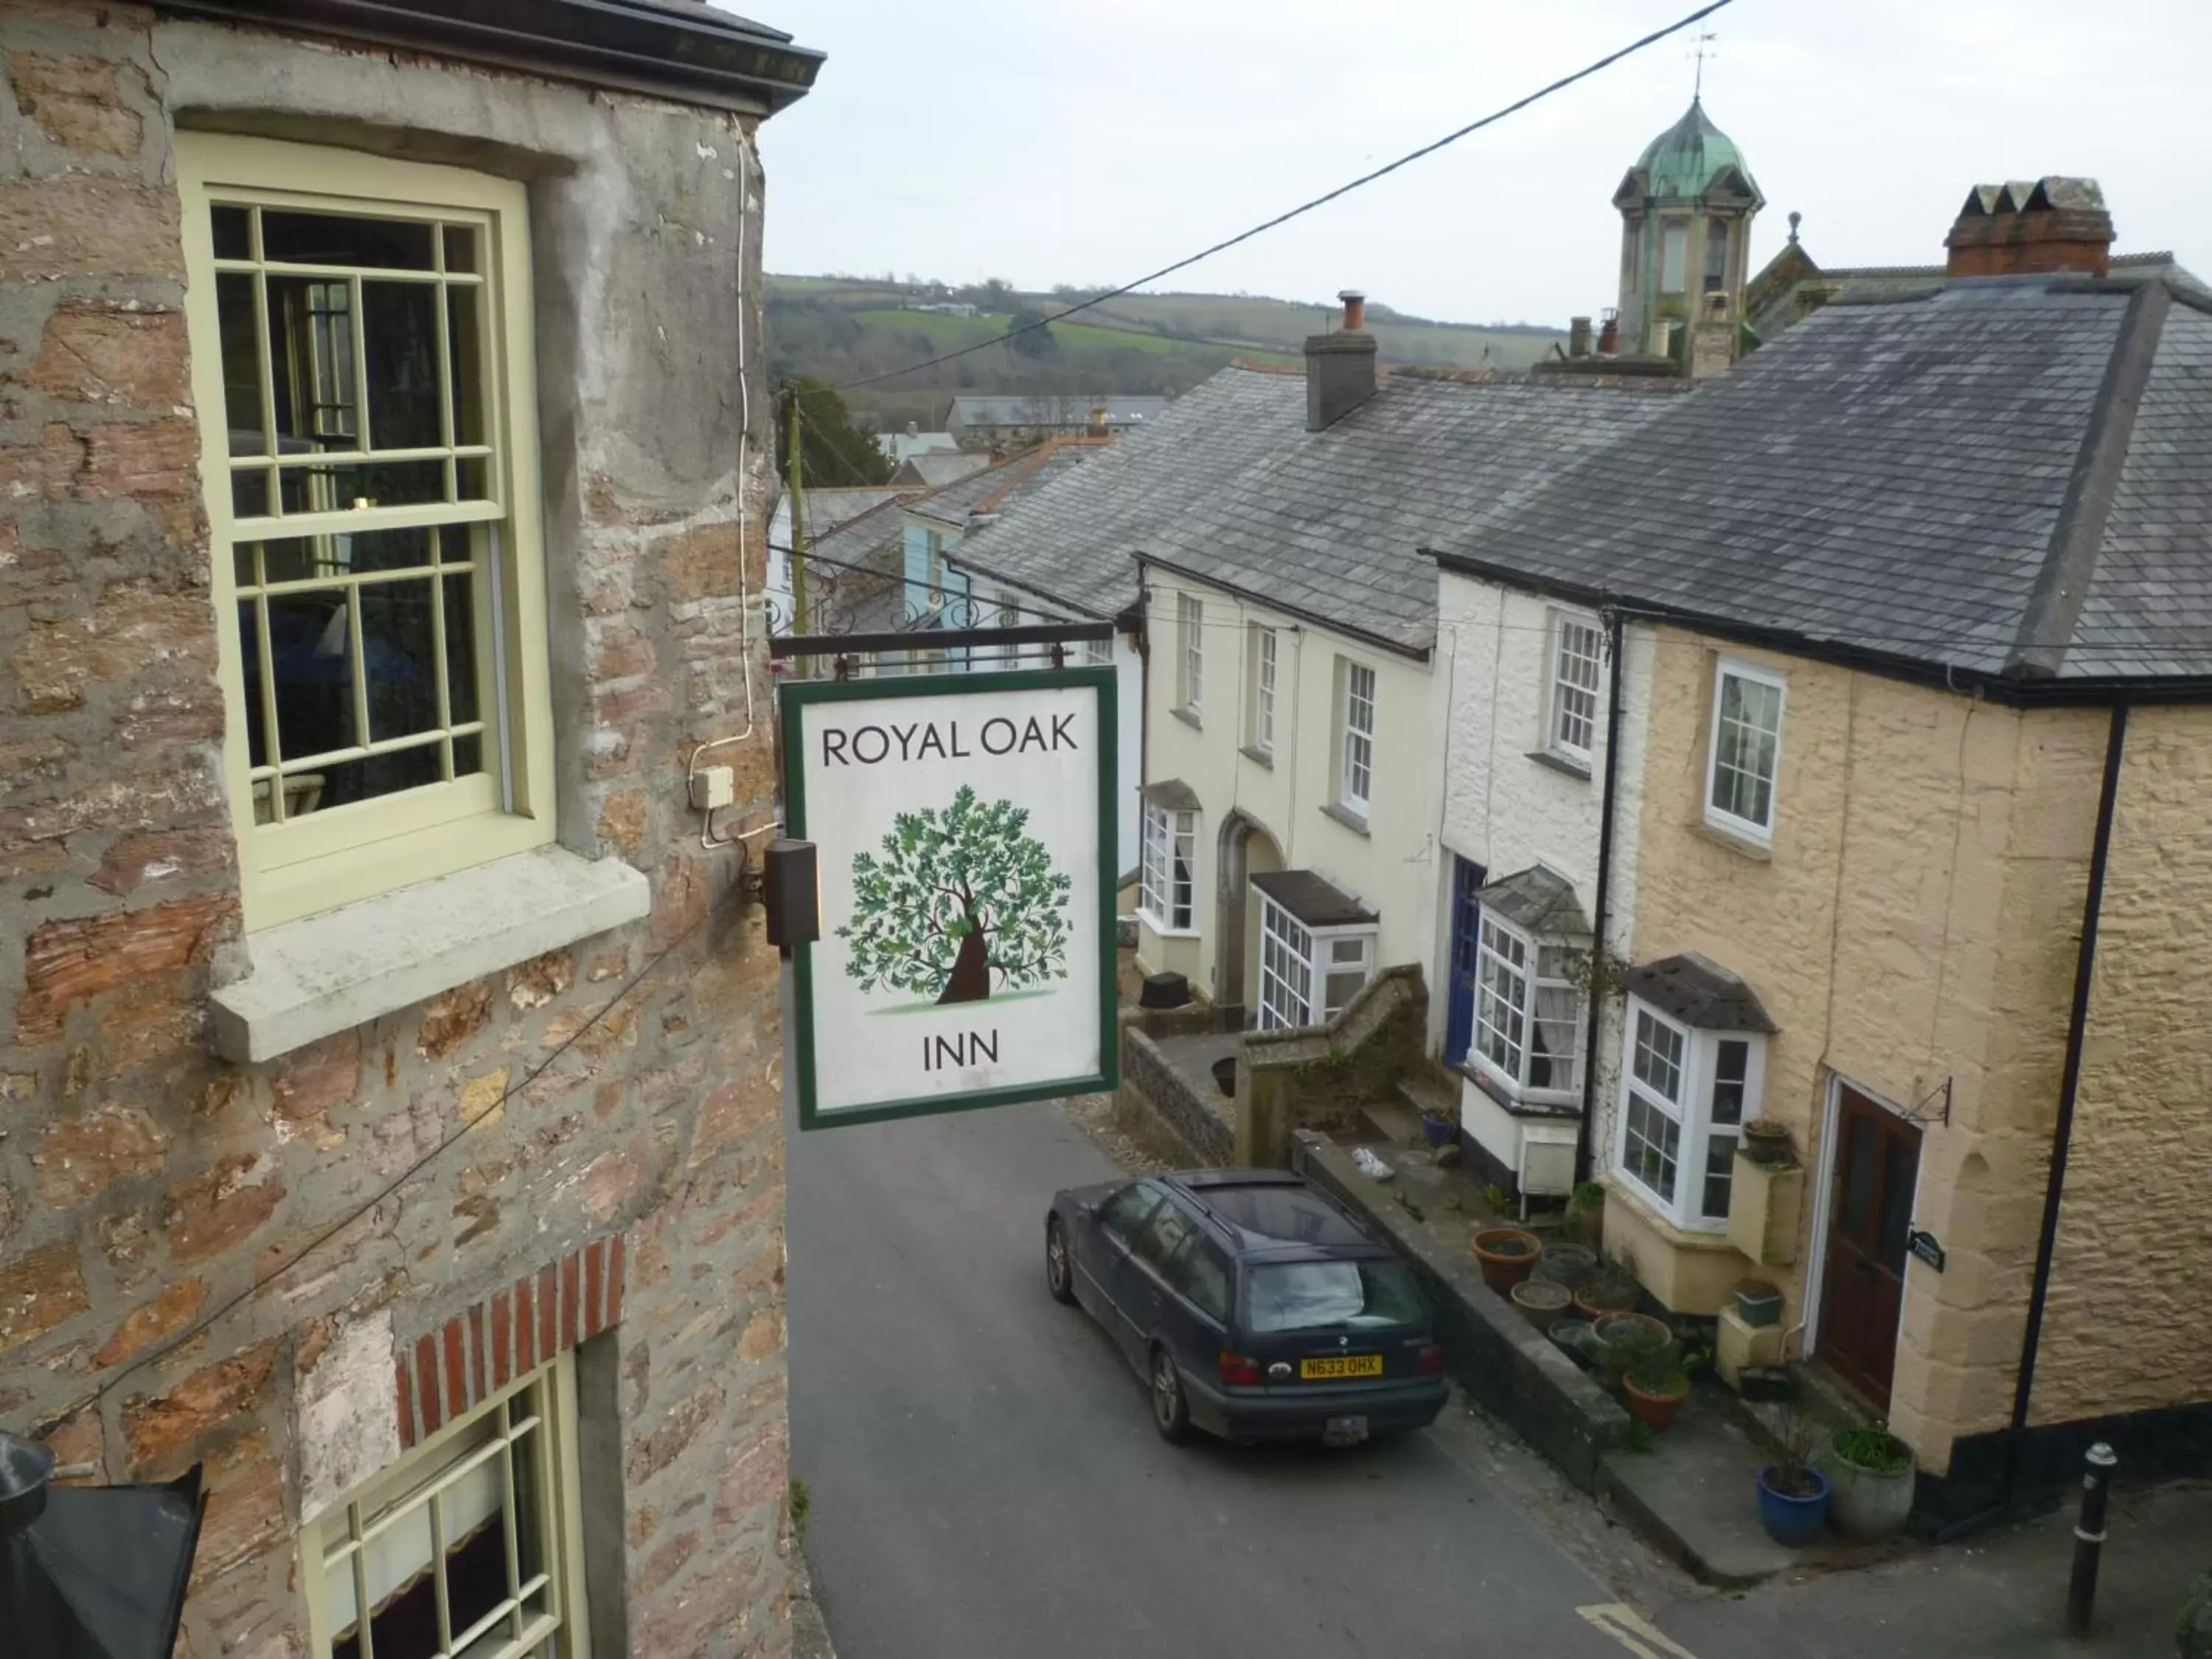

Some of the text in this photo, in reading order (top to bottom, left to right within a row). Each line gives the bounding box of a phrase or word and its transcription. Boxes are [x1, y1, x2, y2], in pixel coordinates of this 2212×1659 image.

[822, 713, 1079, 767] ROYAL OAK
[923, 1029, 998, 1071] INN
[1307, 1359, 1345, 1376] N633
